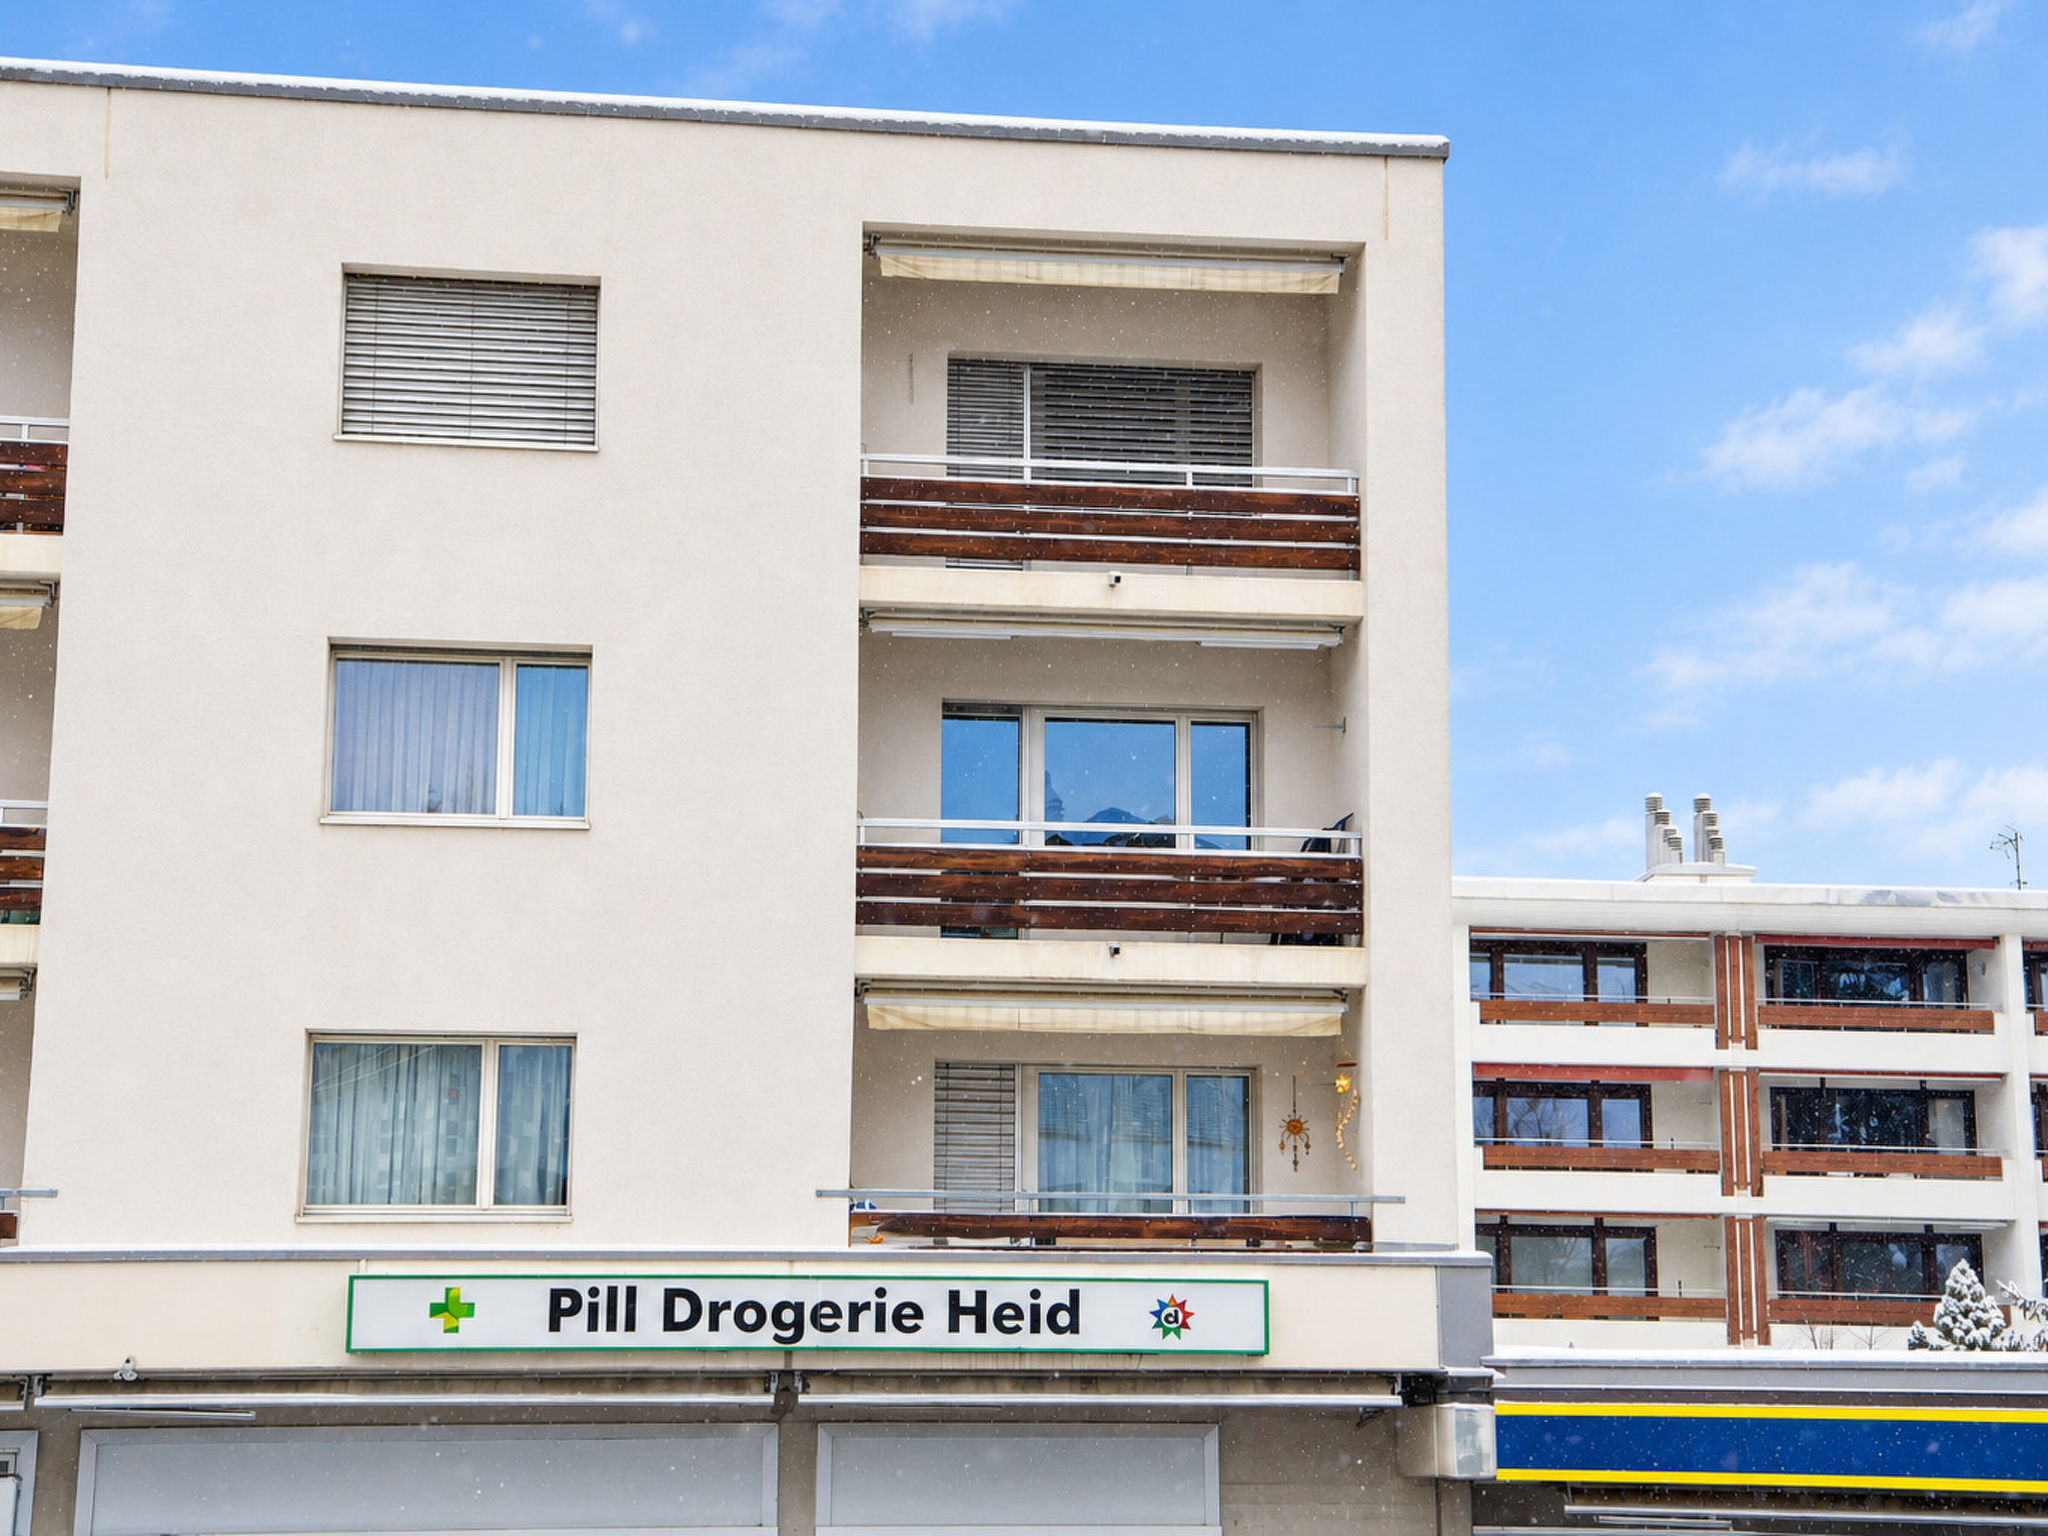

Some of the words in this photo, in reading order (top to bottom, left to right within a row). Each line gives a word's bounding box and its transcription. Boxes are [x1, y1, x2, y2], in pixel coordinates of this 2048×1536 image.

[548, 1285, 637, 1333] Pill
[662, 1286, 924, 1345] Drogerie
[948, 1288, 1080, 1335] Heid
[1163, 1309, 1179, 1325] d
